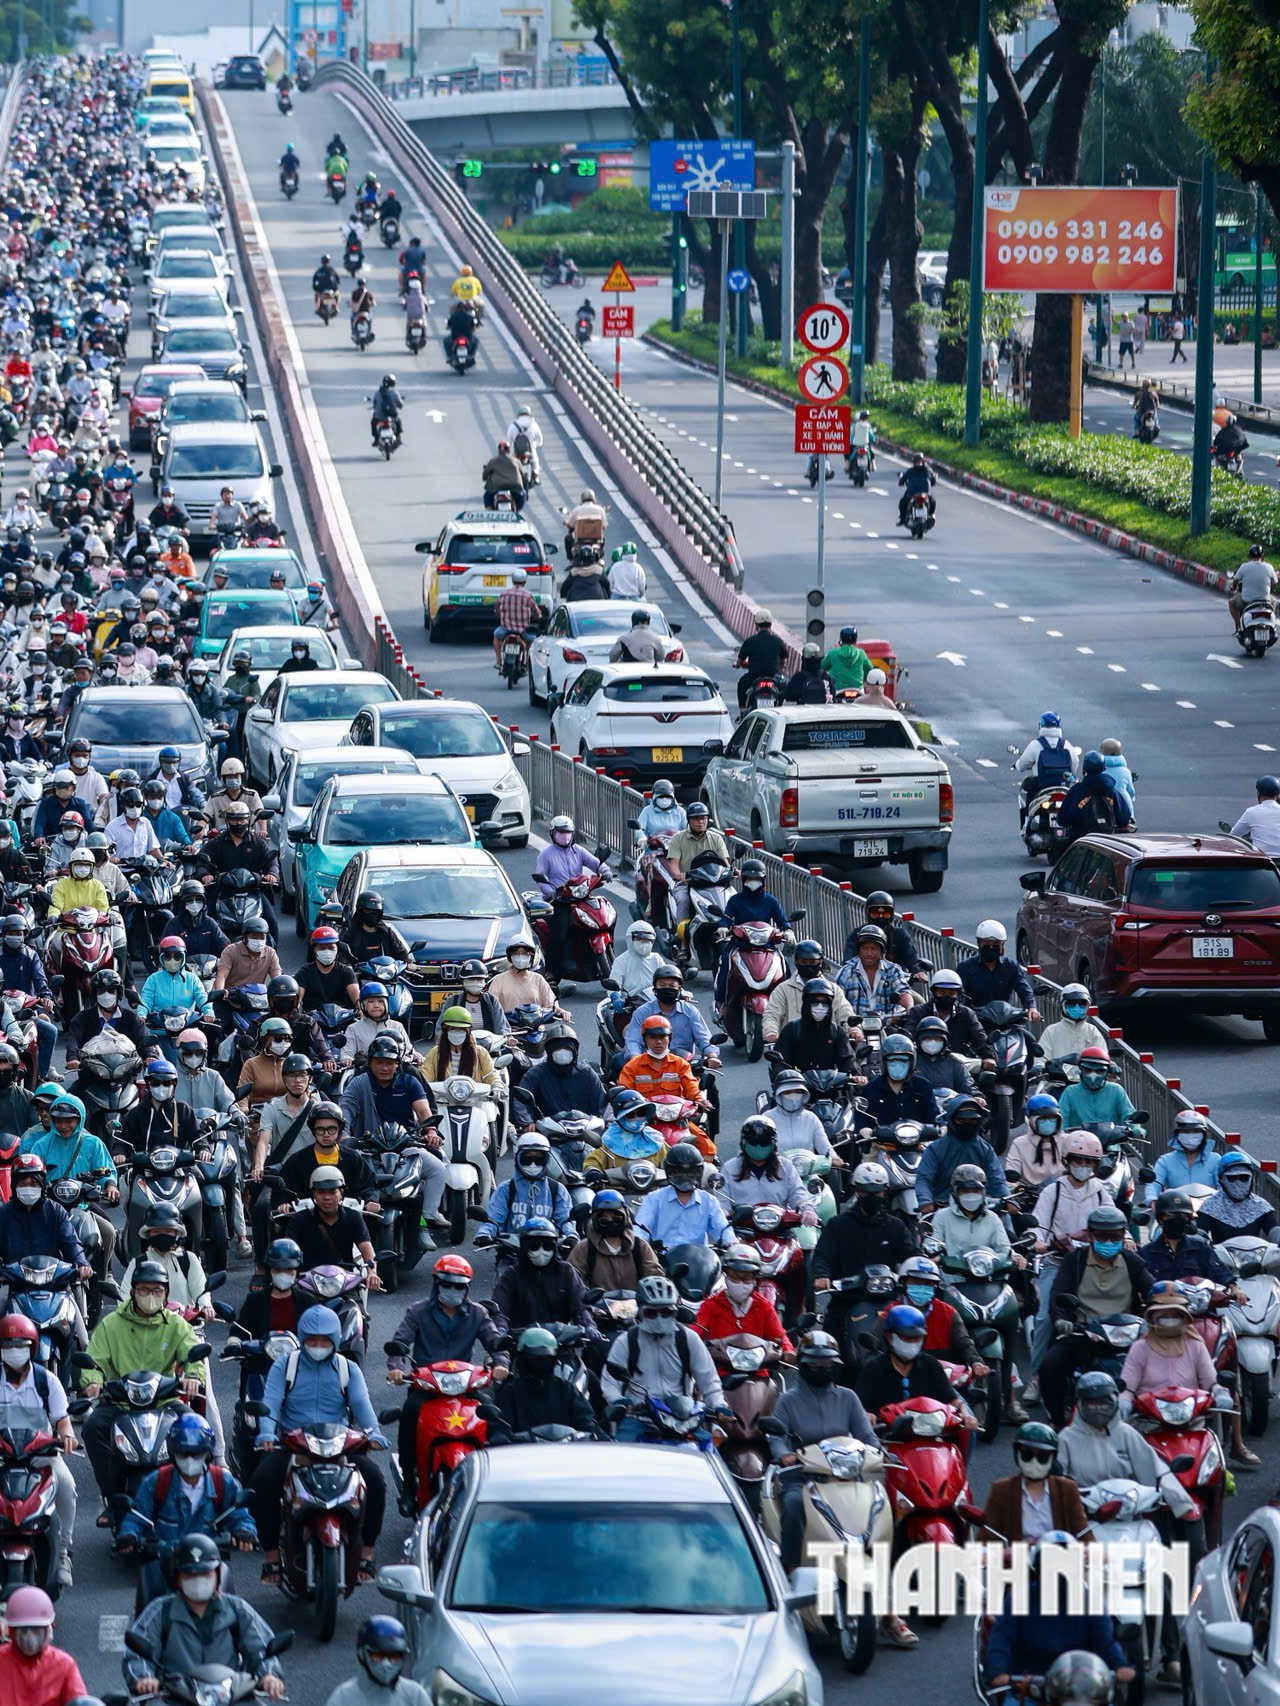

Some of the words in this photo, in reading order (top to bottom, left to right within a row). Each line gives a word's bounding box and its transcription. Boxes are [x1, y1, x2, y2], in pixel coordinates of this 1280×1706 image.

[998, 219, 1058, 239] 0906
[1065, 220, 1107, 239] 331
[1118, 220, 1163, 240] 246
[998, 245, 1058, 264] 0909
[1065, 245, 1110, 265] 982
[1118, 245, 1163, 265] 246
[809, 406, 839, 420] CẤM
[802, 421, 813, 429] XE
[835, 420, 844, 429] VÀ
[802, 432, 813, 440] XE
[816, 432, 822, 440] 3
[824, 430, 844, 440] BÁNH
[800, 442, 816, 451] LƯU
[822, 441, 845, 452] THÔNG
[838, 806, 901, 820] 51L-719.24
[863, 840, 879, 848] 51L
[858, 848, 885, 856] 719.24
[1203, 938, 1222, 947] 51S
